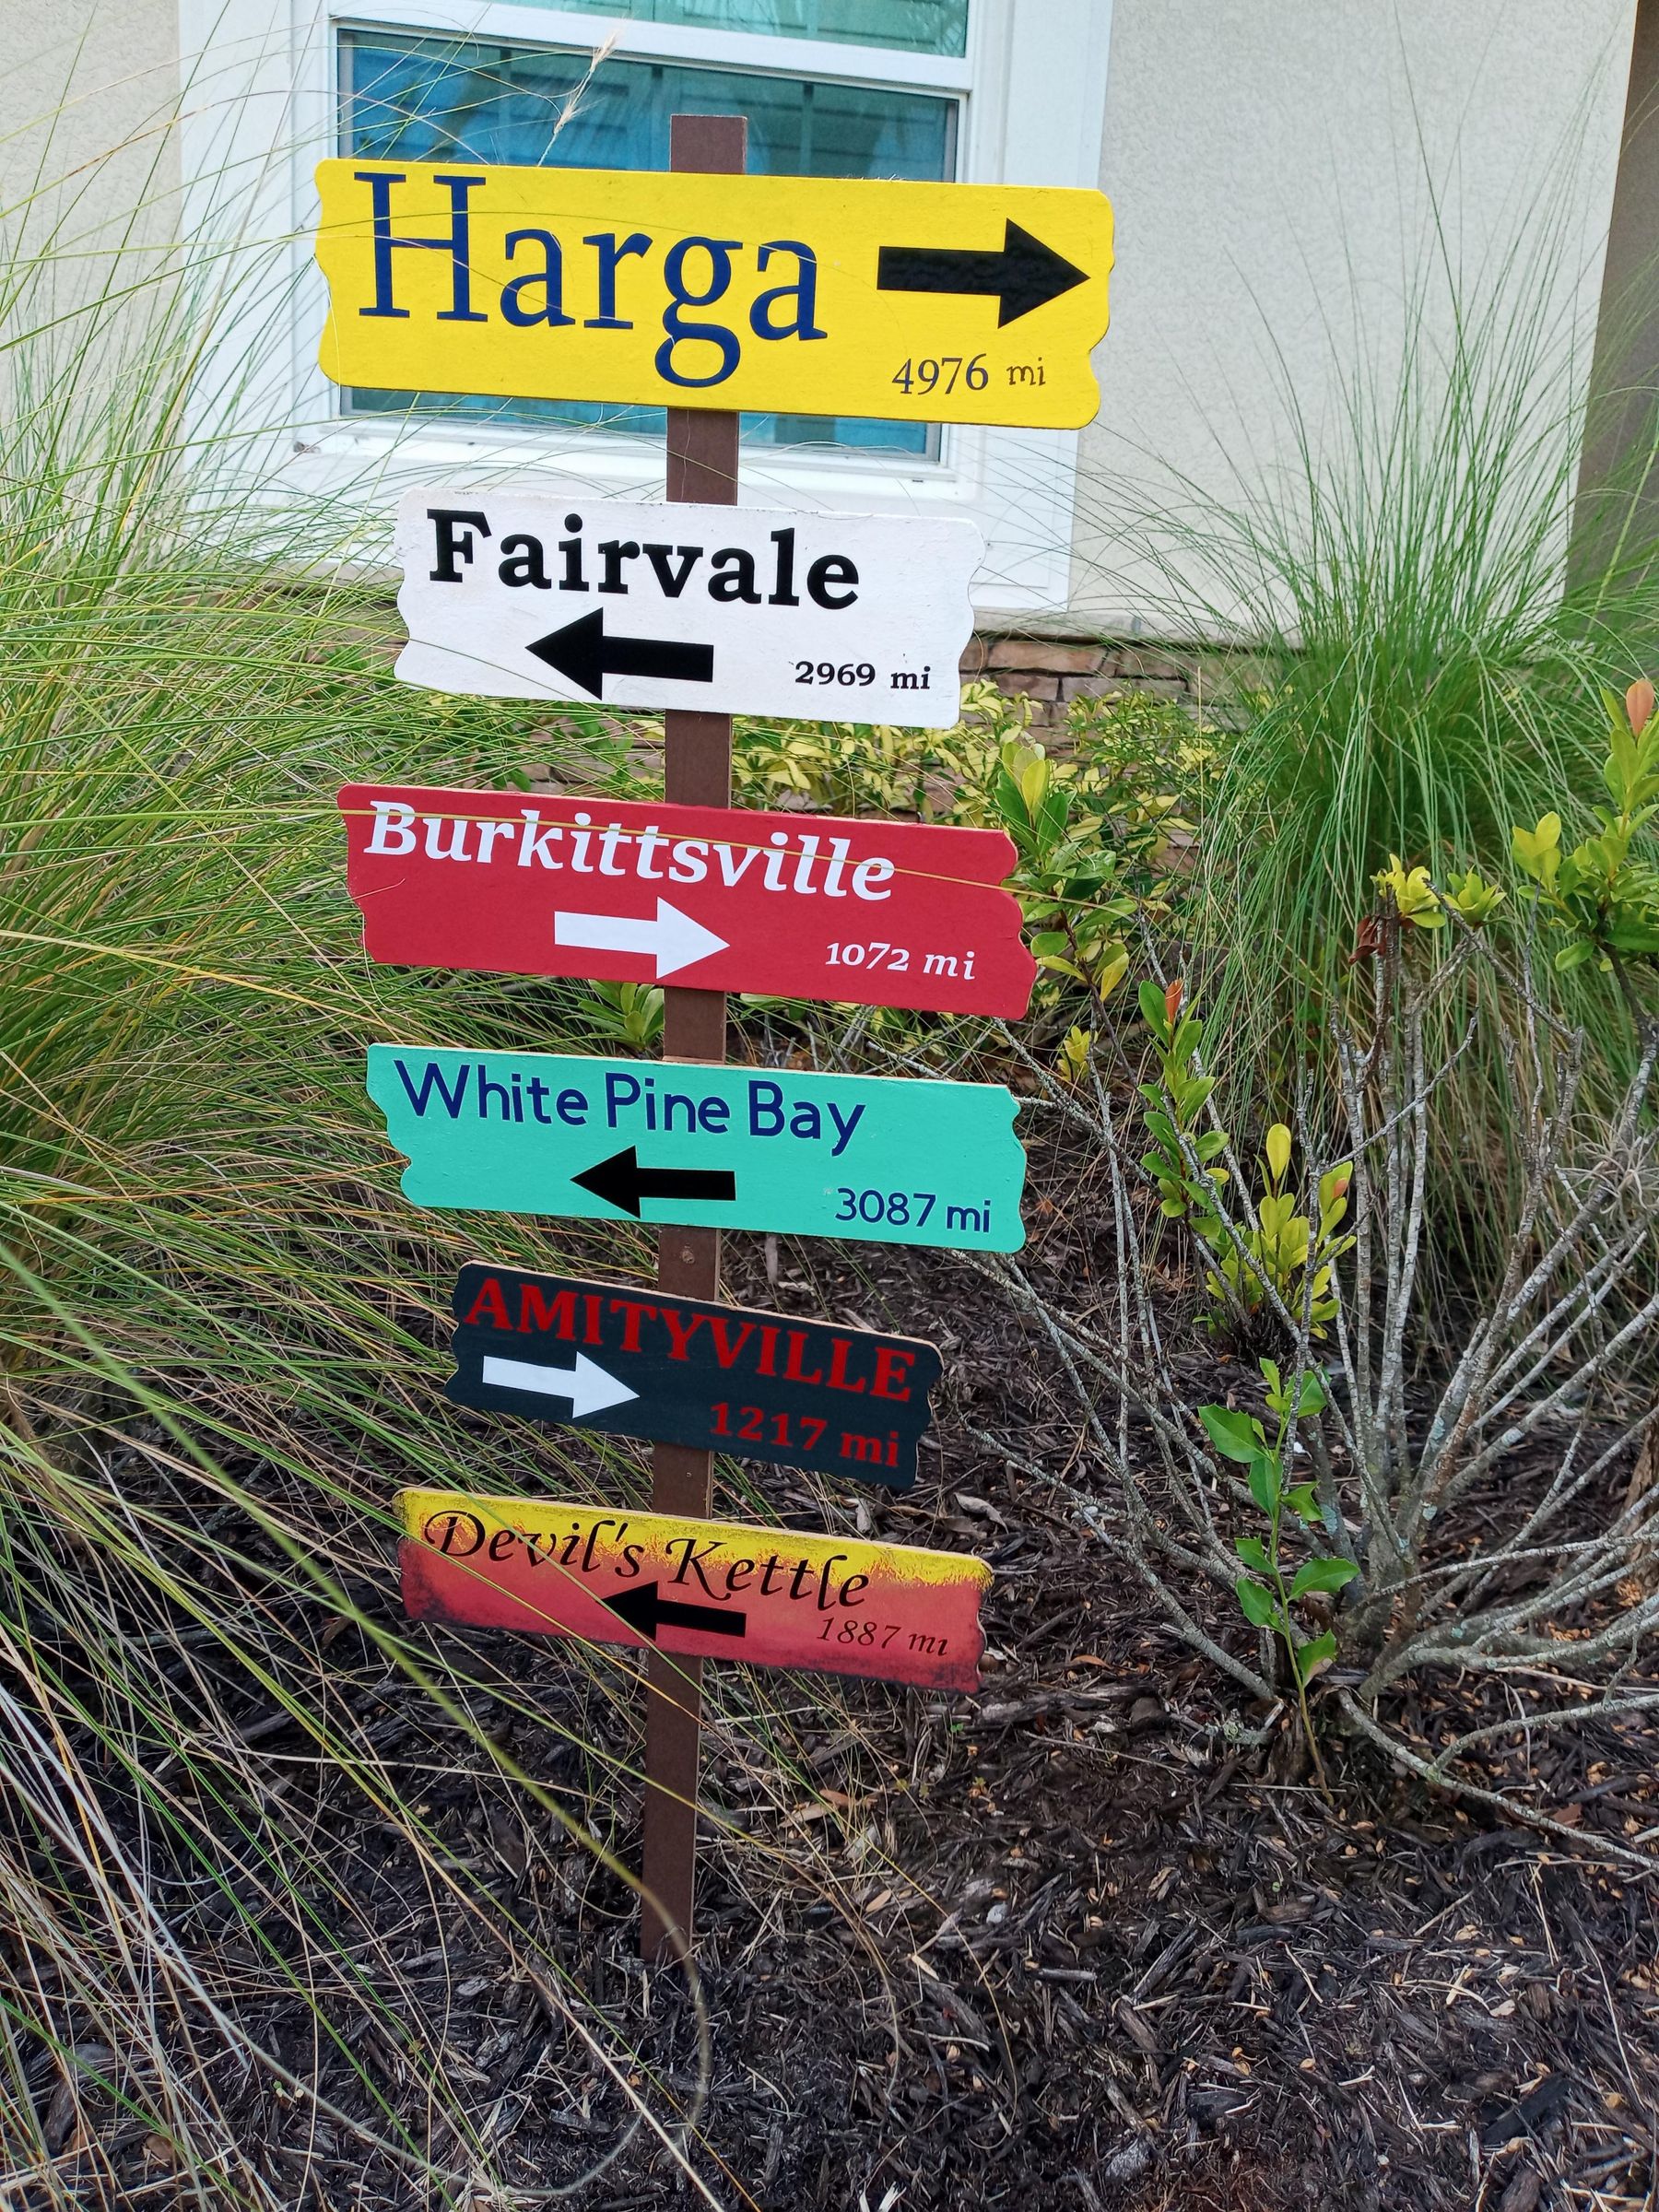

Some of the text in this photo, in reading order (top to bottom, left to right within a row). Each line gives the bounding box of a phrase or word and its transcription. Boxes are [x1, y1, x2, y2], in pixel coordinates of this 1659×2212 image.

[354, 171, 828, 388] Harga
[892, 352, 1046, 396] 4976 mi
[427, 507, 859, 610] Fairvale
[794, 660, 930, 690] 2969 mi
[364, 799, 896, 901] Burkittsville
[825, 940, 976, 982] 1072 mi
[393, 1059, 866, 1157] White Pine Bay
[834, 1187, 991, 1234] 3087 mi
[464, 1277, 916, 1403] AMITYVILLE
[710, 1401, 899, 1467] 1217 mi
[423, 1509, 871, 1612] Devil's Kettle
[816, 1615, 949, 1657] 1887 mi
